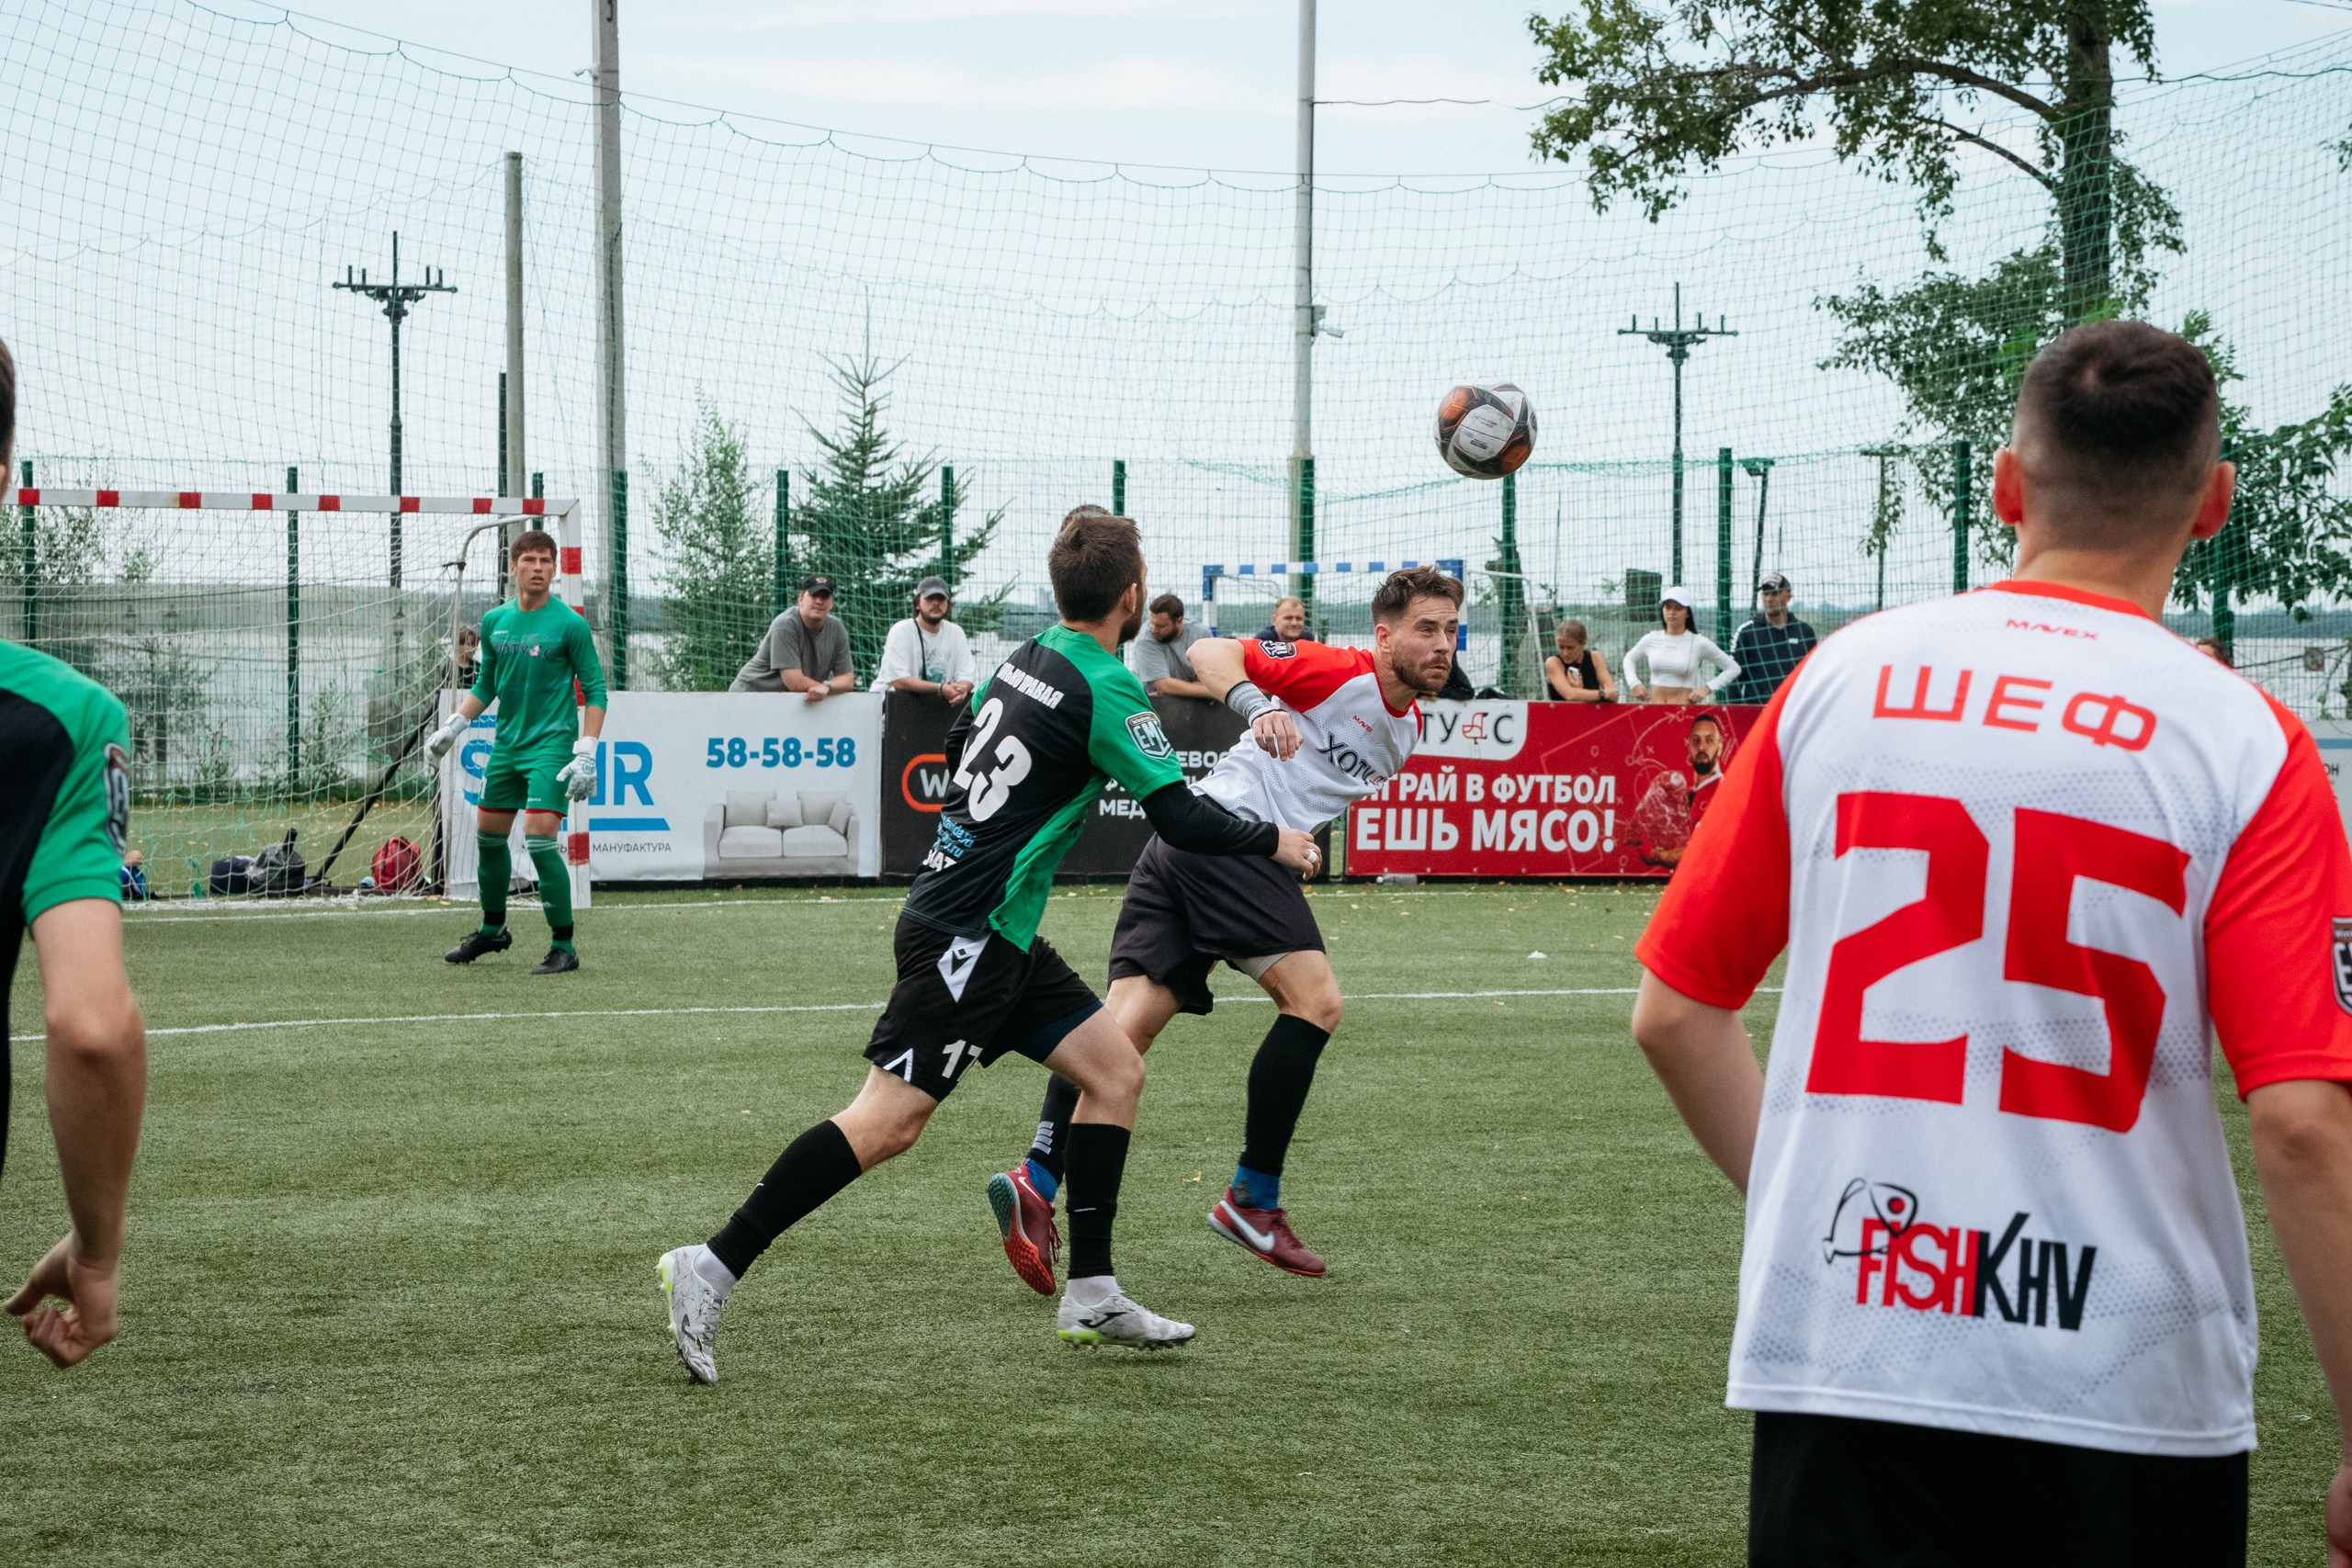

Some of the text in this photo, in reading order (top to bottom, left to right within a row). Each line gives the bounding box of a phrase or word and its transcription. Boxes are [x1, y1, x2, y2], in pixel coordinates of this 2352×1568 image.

[1872, 664, 2157, 752] ШЕФ
[706, 737, 856, 768] 58-58-58
[953, 697, 1033, 822] 23
[1465, 773, 1485, 802] В
[1491, 773, 1615, 804] ФУТБОЛ
[593, 842, 672, 853] МАНУФАКТУРА
[1356, 807, 1615, 852] ЕШЬ МЯСО!
[1805, 789, 2192, 1135] 25
